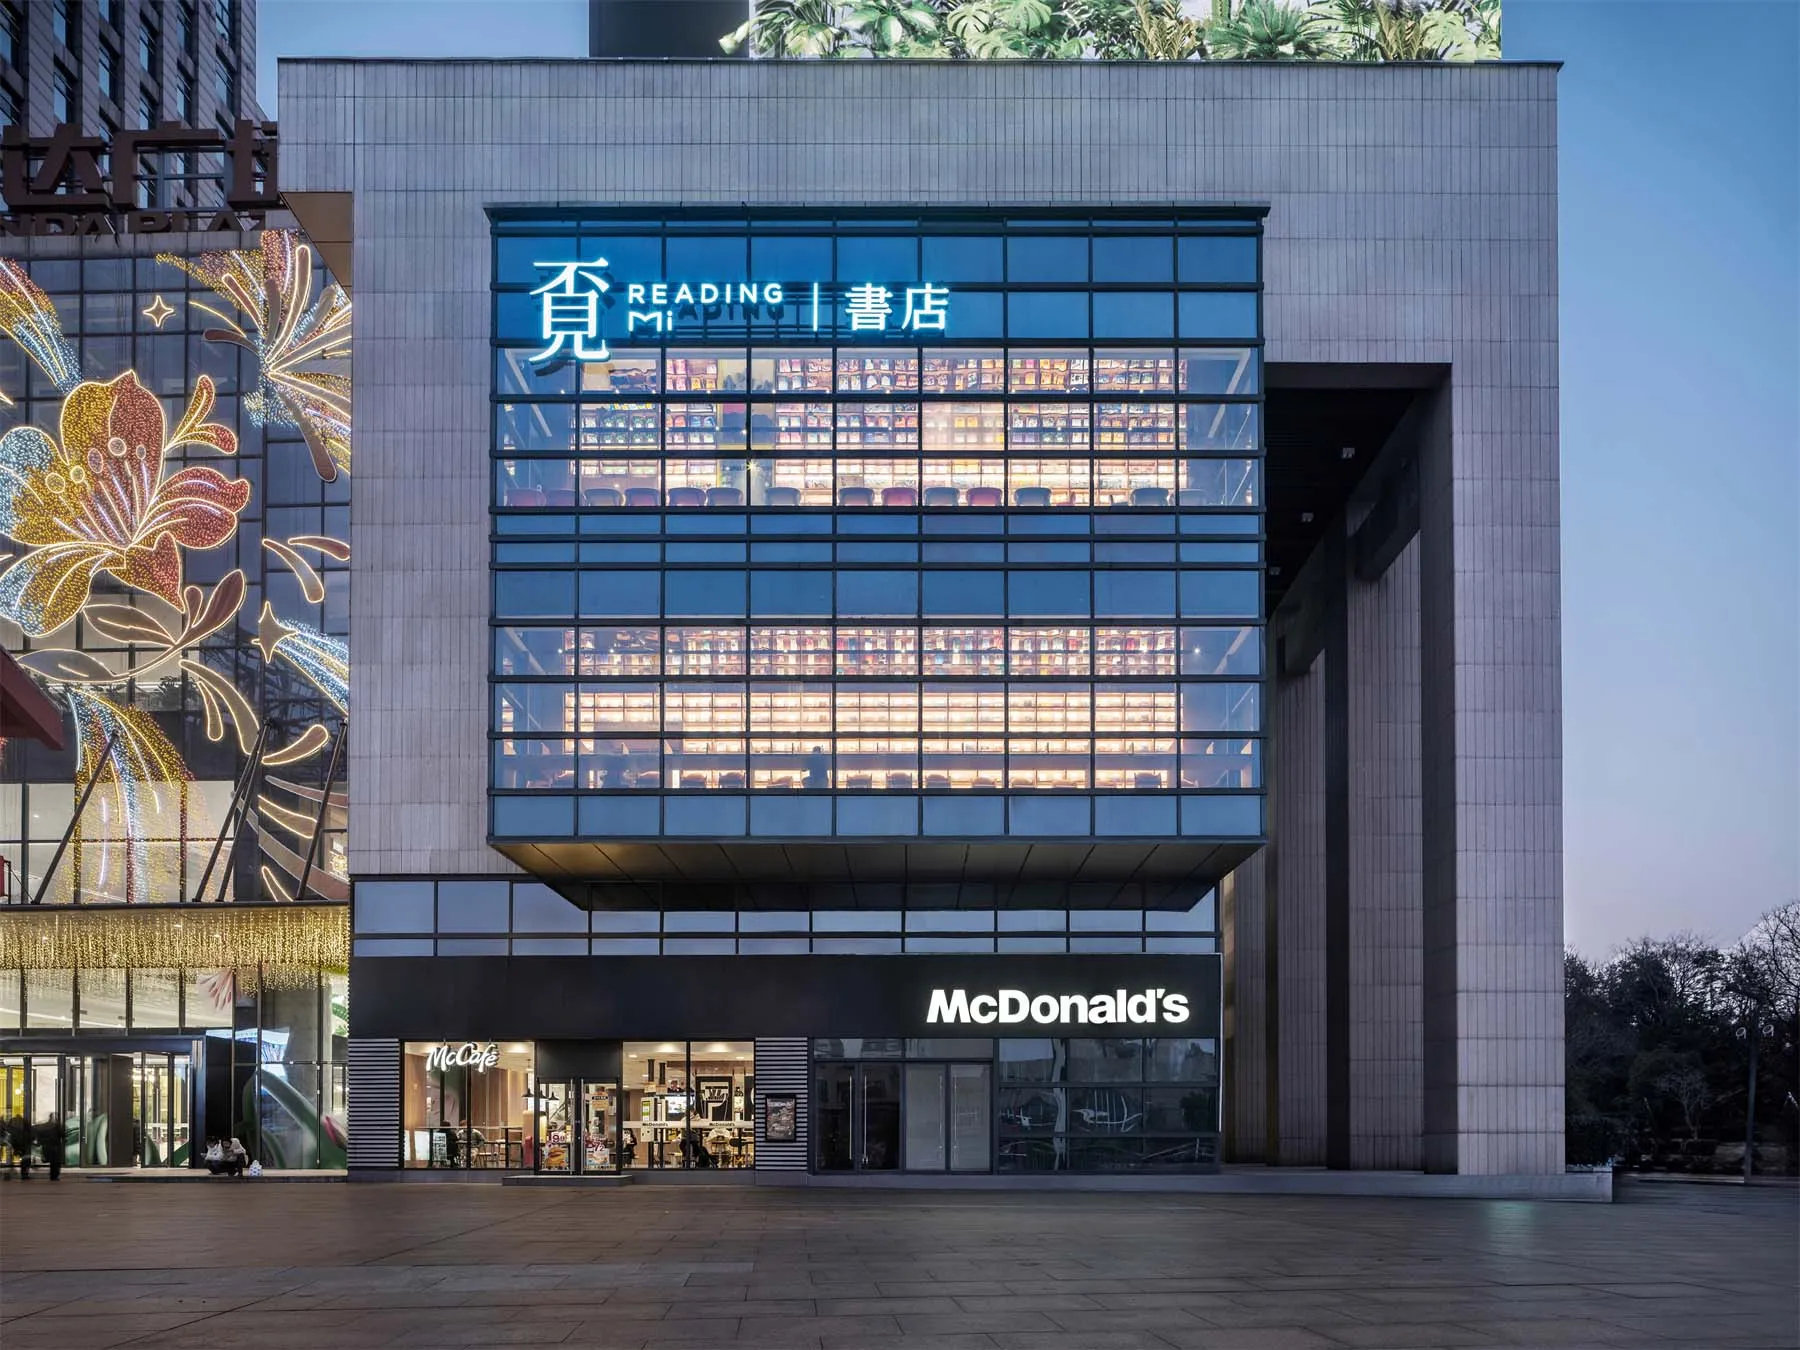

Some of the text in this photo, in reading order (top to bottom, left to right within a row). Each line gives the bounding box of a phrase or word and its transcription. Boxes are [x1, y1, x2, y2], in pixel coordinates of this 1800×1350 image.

[628, 283, 783, 304] READING
[845, 283, 949, 331] 書店
[628, 310, 673, 332] Mi
[926, 988, 1190, 1024] McDonald's
[426, 1043, 498, 1072] McCafé
